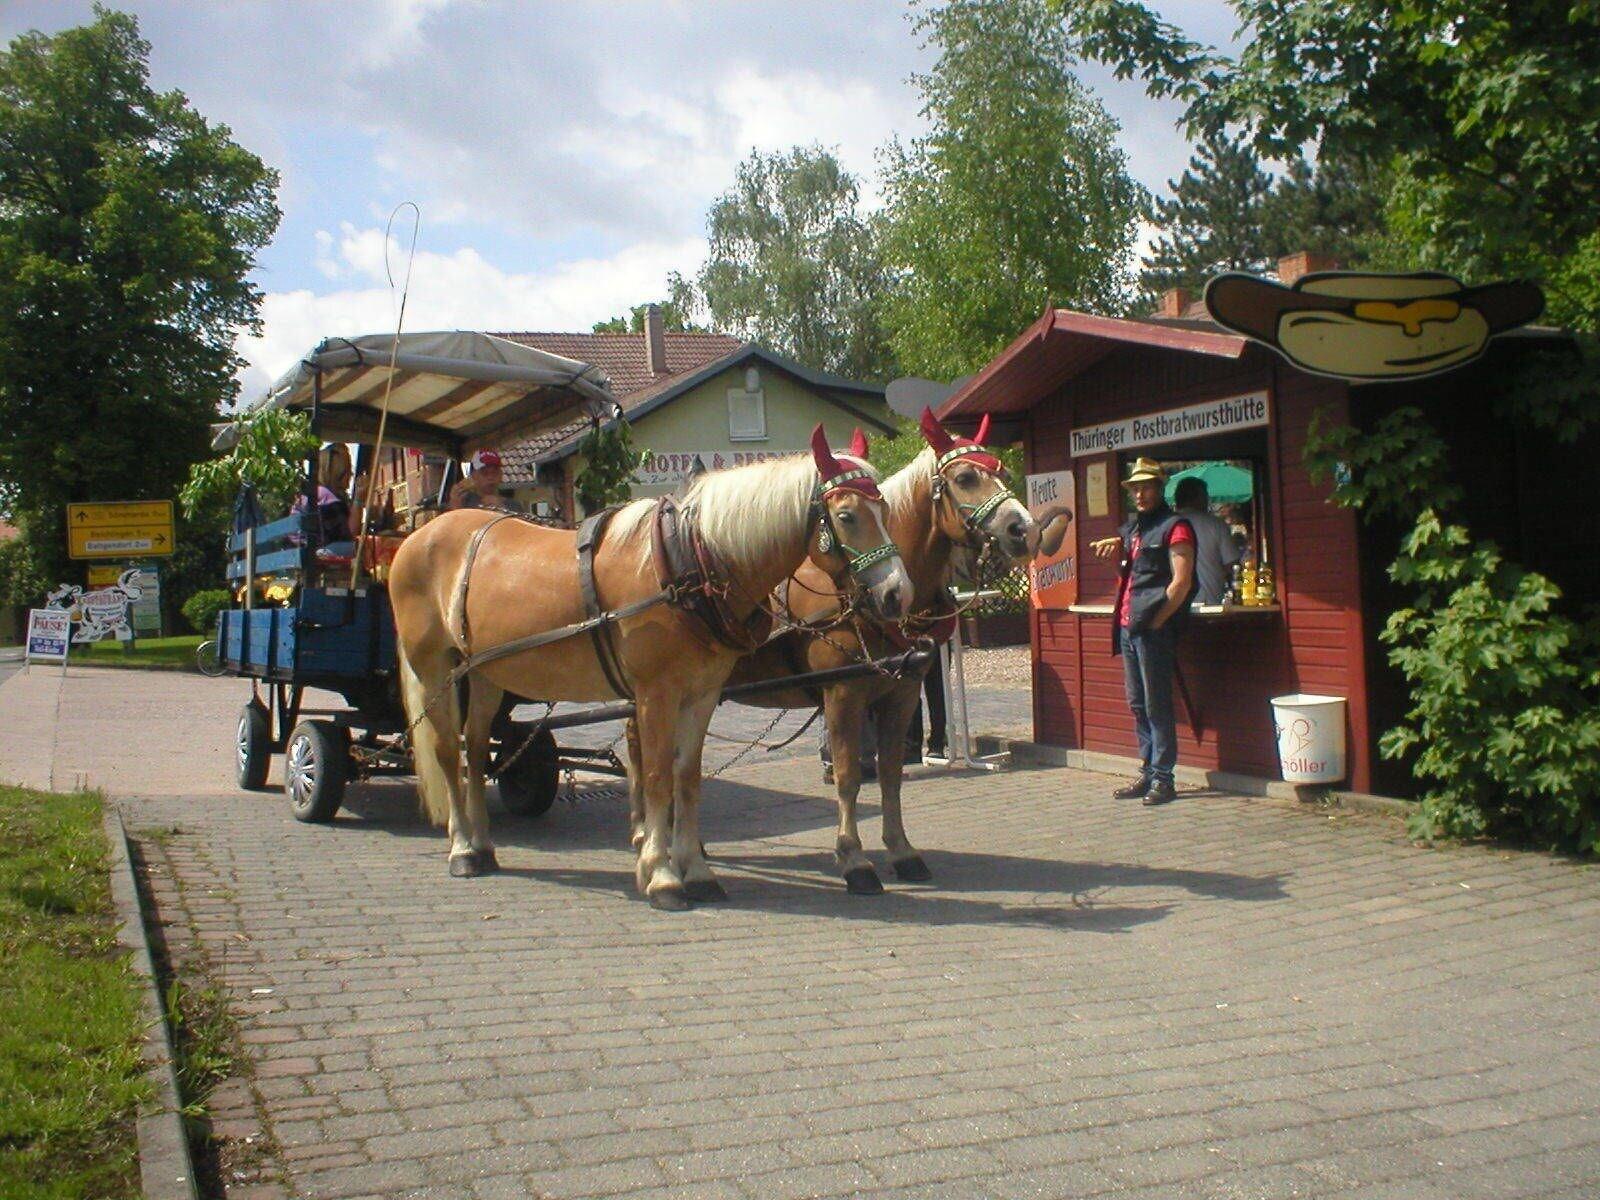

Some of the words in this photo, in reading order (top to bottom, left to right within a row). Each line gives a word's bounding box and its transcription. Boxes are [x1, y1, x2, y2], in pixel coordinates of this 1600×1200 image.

[1072, 426, 1125, 452] Thüringer
[1133, 398, 1265, 441] Rostbratwursthütte
[643, 452, 696, 473] HOTE
[1031, 477, 1058, 506] Heute
